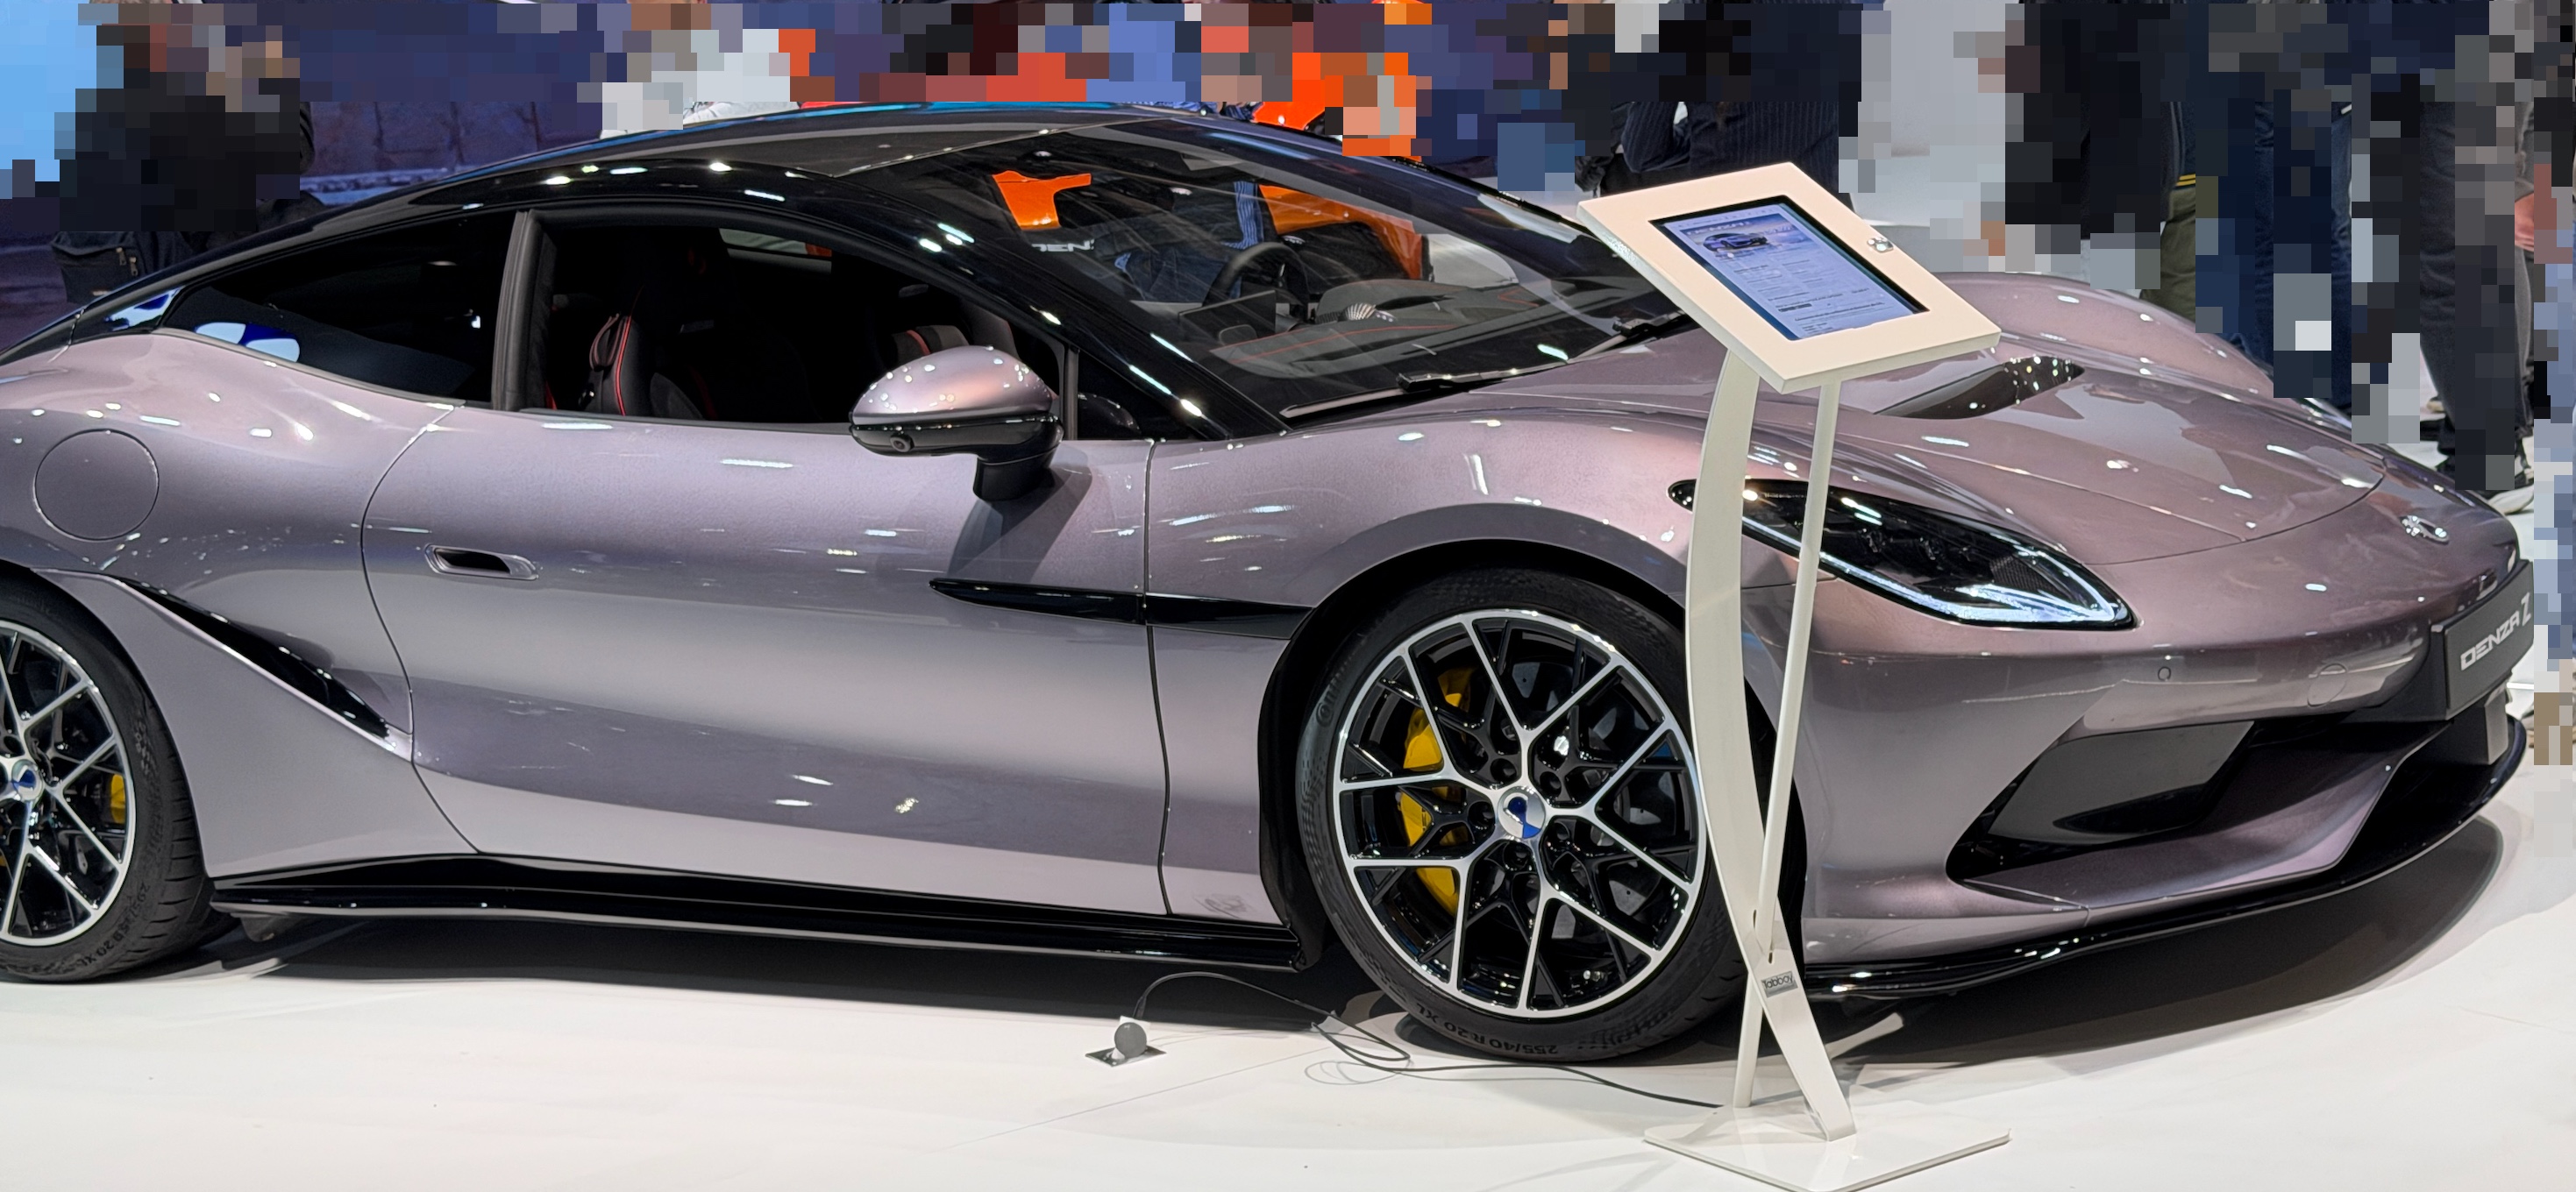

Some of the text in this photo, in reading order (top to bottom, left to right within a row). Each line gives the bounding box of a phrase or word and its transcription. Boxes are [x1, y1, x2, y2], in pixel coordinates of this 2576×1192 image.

[2460, 592, 2532, 670] DENZA Z
[1416, 1003, 1558, 1054] 255/40 R 20 XL
